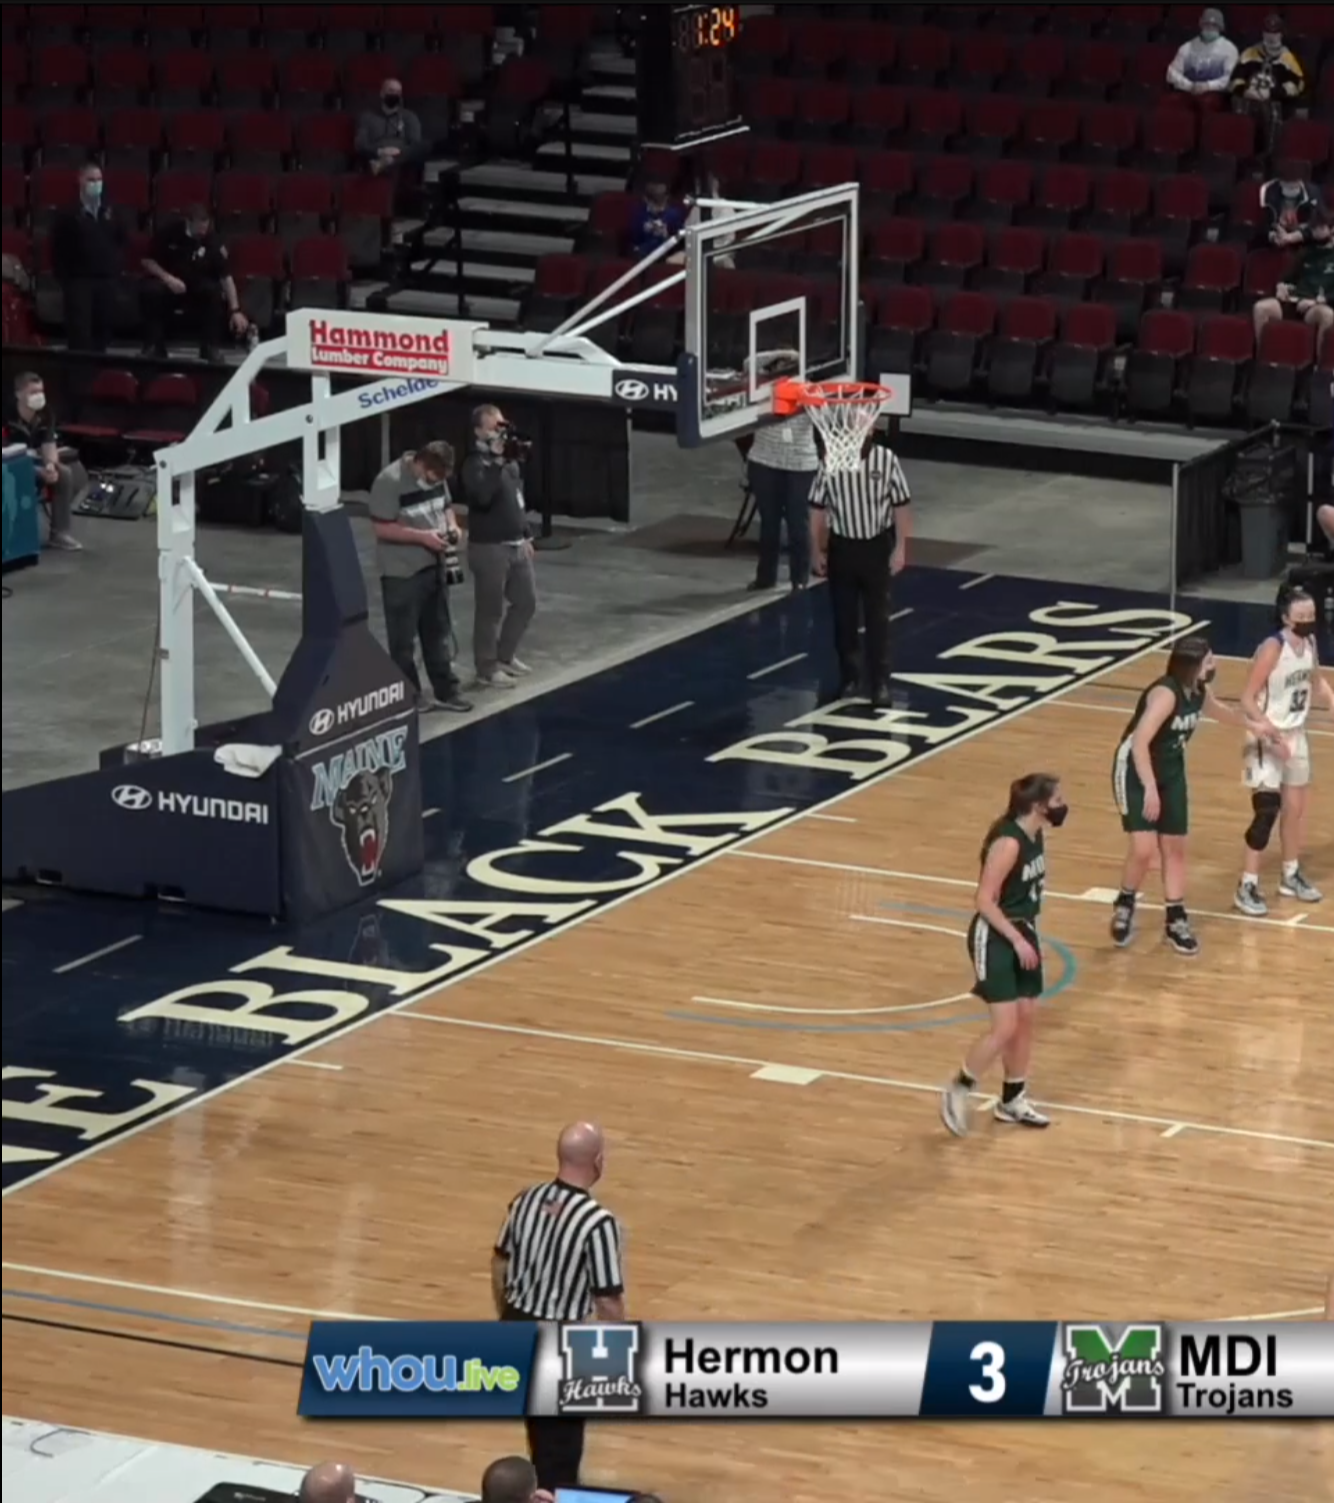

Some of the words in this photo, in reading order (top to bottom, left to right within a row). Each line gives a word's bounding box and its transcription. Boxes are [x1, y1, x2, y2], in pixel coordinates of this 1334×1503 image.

[698, 8, 735, 46] 1:24
[309, 319, 450, 353] Hammond
[312, 346, 369, 367] Lumber
[372, 351, 448, 374] Company
[358, 379, 439, 409] Schelde
[337, 681, 405, 725] HYUNDAI
[705, 601, 1193, 780] BEARS
[310, 726, 408, 811] MAINE
[158, 790, 269, 825] HYUNDAI
[118, 792, 797, 1046] BLACK
